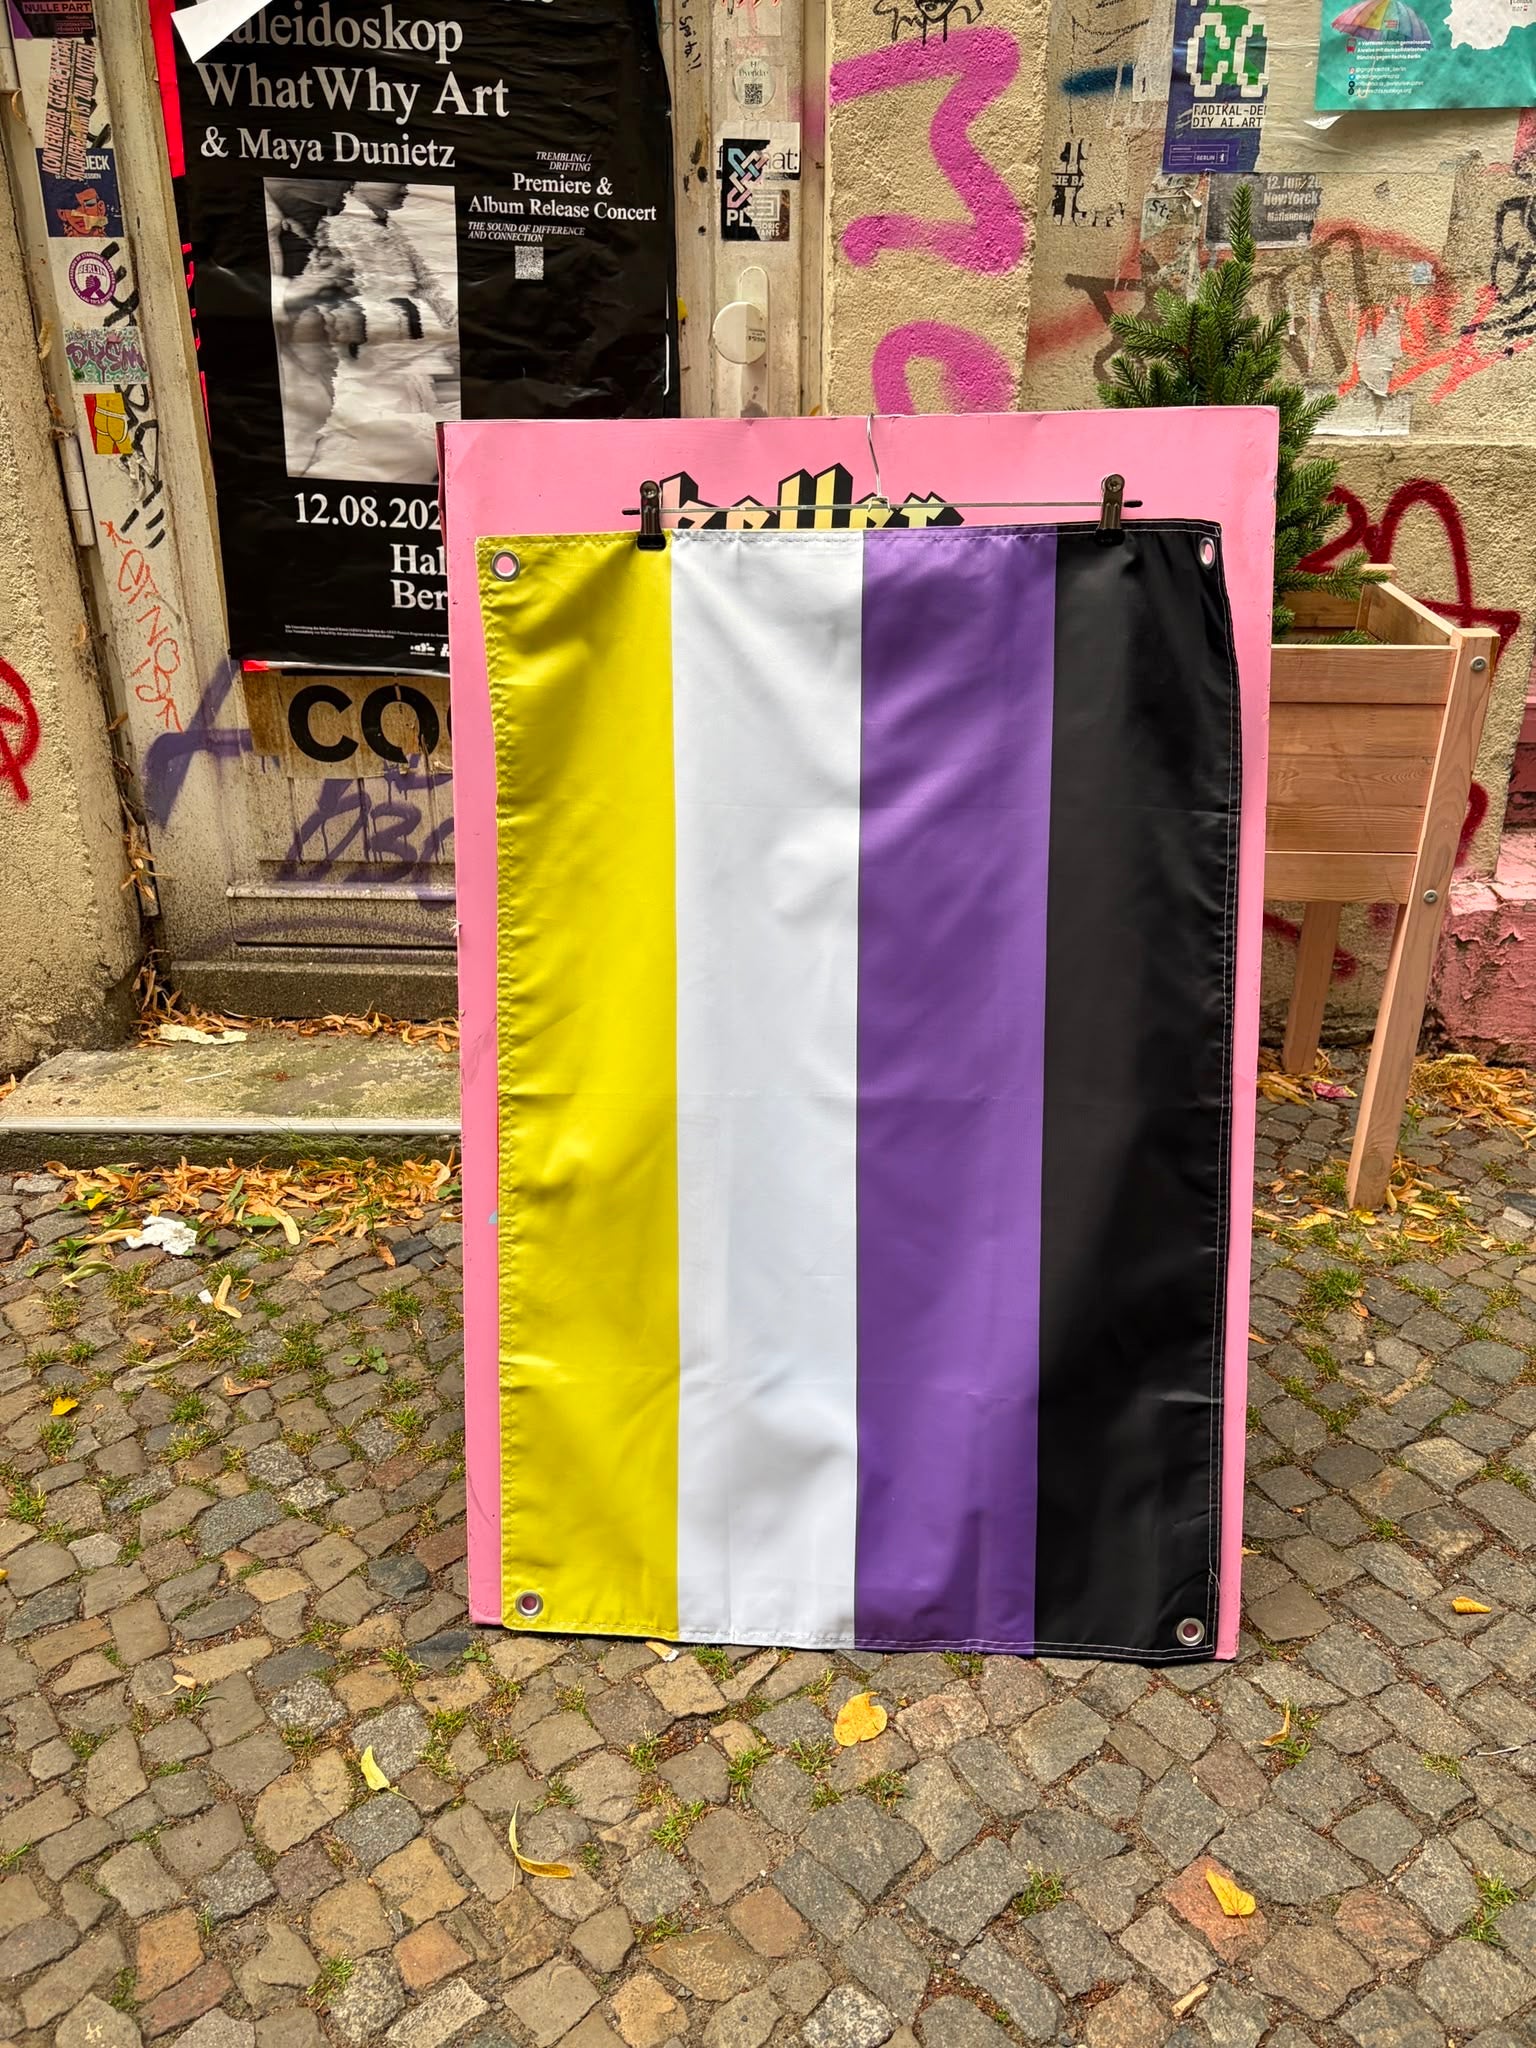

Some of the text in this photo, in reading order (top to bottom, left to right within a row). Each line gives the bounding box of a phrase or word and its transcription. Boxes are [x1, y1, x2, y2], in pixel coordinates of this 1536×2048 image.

[24, 3, 90, 12] NULLE PART
[220, 0, 463, 64] aleidoskop
[76, 43, 97, 77] KOTZEN
[48, 72, 70, 111] GEGEN
[74, 77, 95, 99] ZUM
[432, 70, 509, 118] Art
[1192, 117, 1263, 128] DIY AI.ART
[42, 110, 67, 176] KONTERBIER
[200, 126, 455, 169] & Maya Dunietz
[536, 151, 587, 163] TREMBLING
[549, 162, 592, 172] DRIFTING
[511, 172, 613, 196] Premiere &
[468, 195, 657, 221] Album Release Concert
[468, 221, 586, 236] THE SOUND OF DIFFERENCE
[468, 231, 544, 242] AND CONNECTION
[78, 263, 107, 277] BERLIN
[390, 543, 447, 576] Hal
[390, 578, 448, 611] Ber
[287, 684, 452, 764] CO
